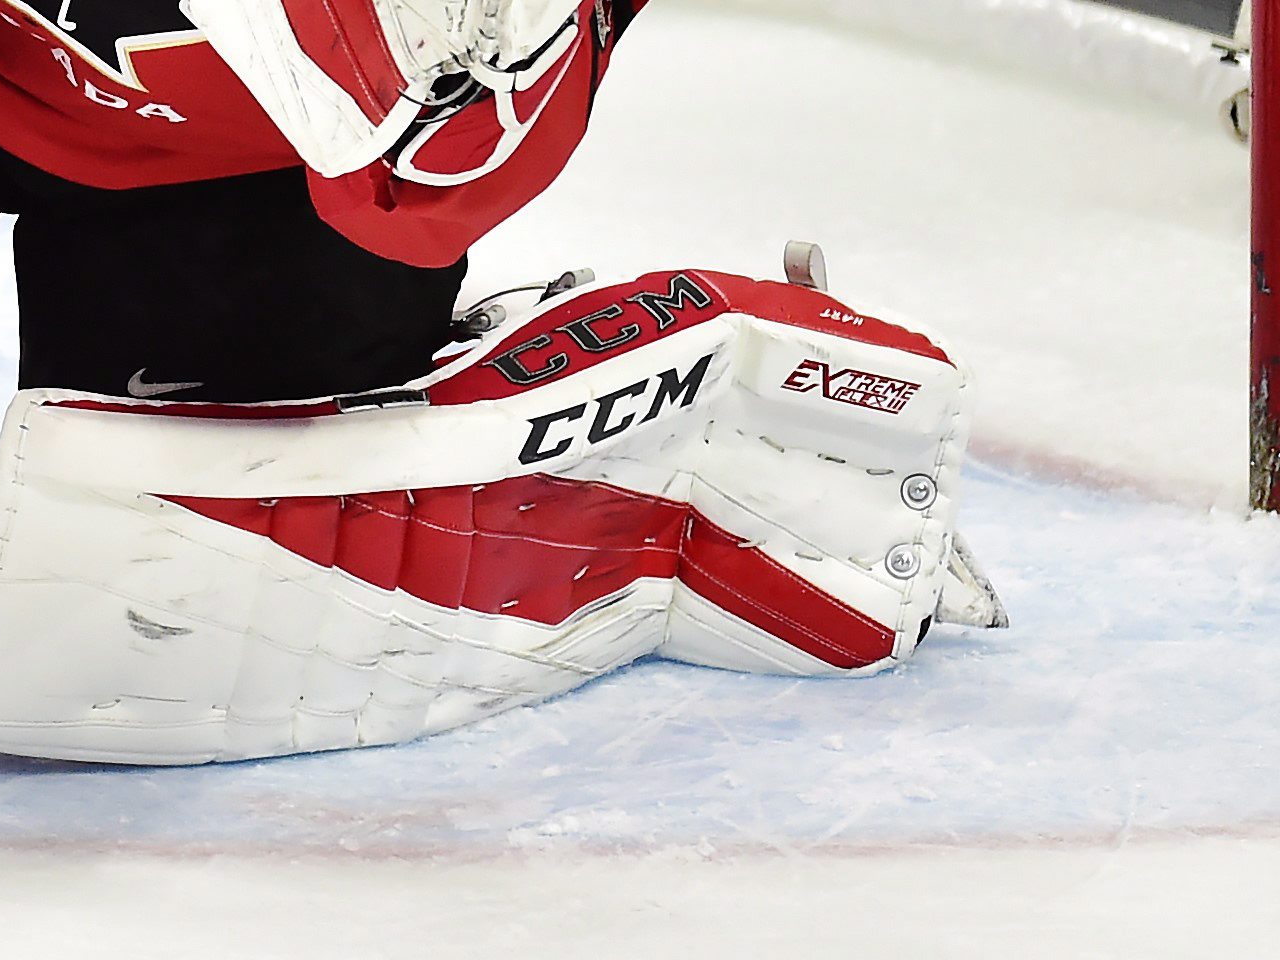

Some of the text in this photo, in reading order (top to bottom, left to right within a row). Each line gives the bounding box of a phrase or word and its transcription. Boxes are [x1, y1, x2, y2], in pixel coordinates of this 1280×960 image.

[482, 272, 713, 386] CCM
[818, 307, 865, 327] HART
[517, 352, 715, 466] CCM
[780, 358, 923, 400] EXTREME
